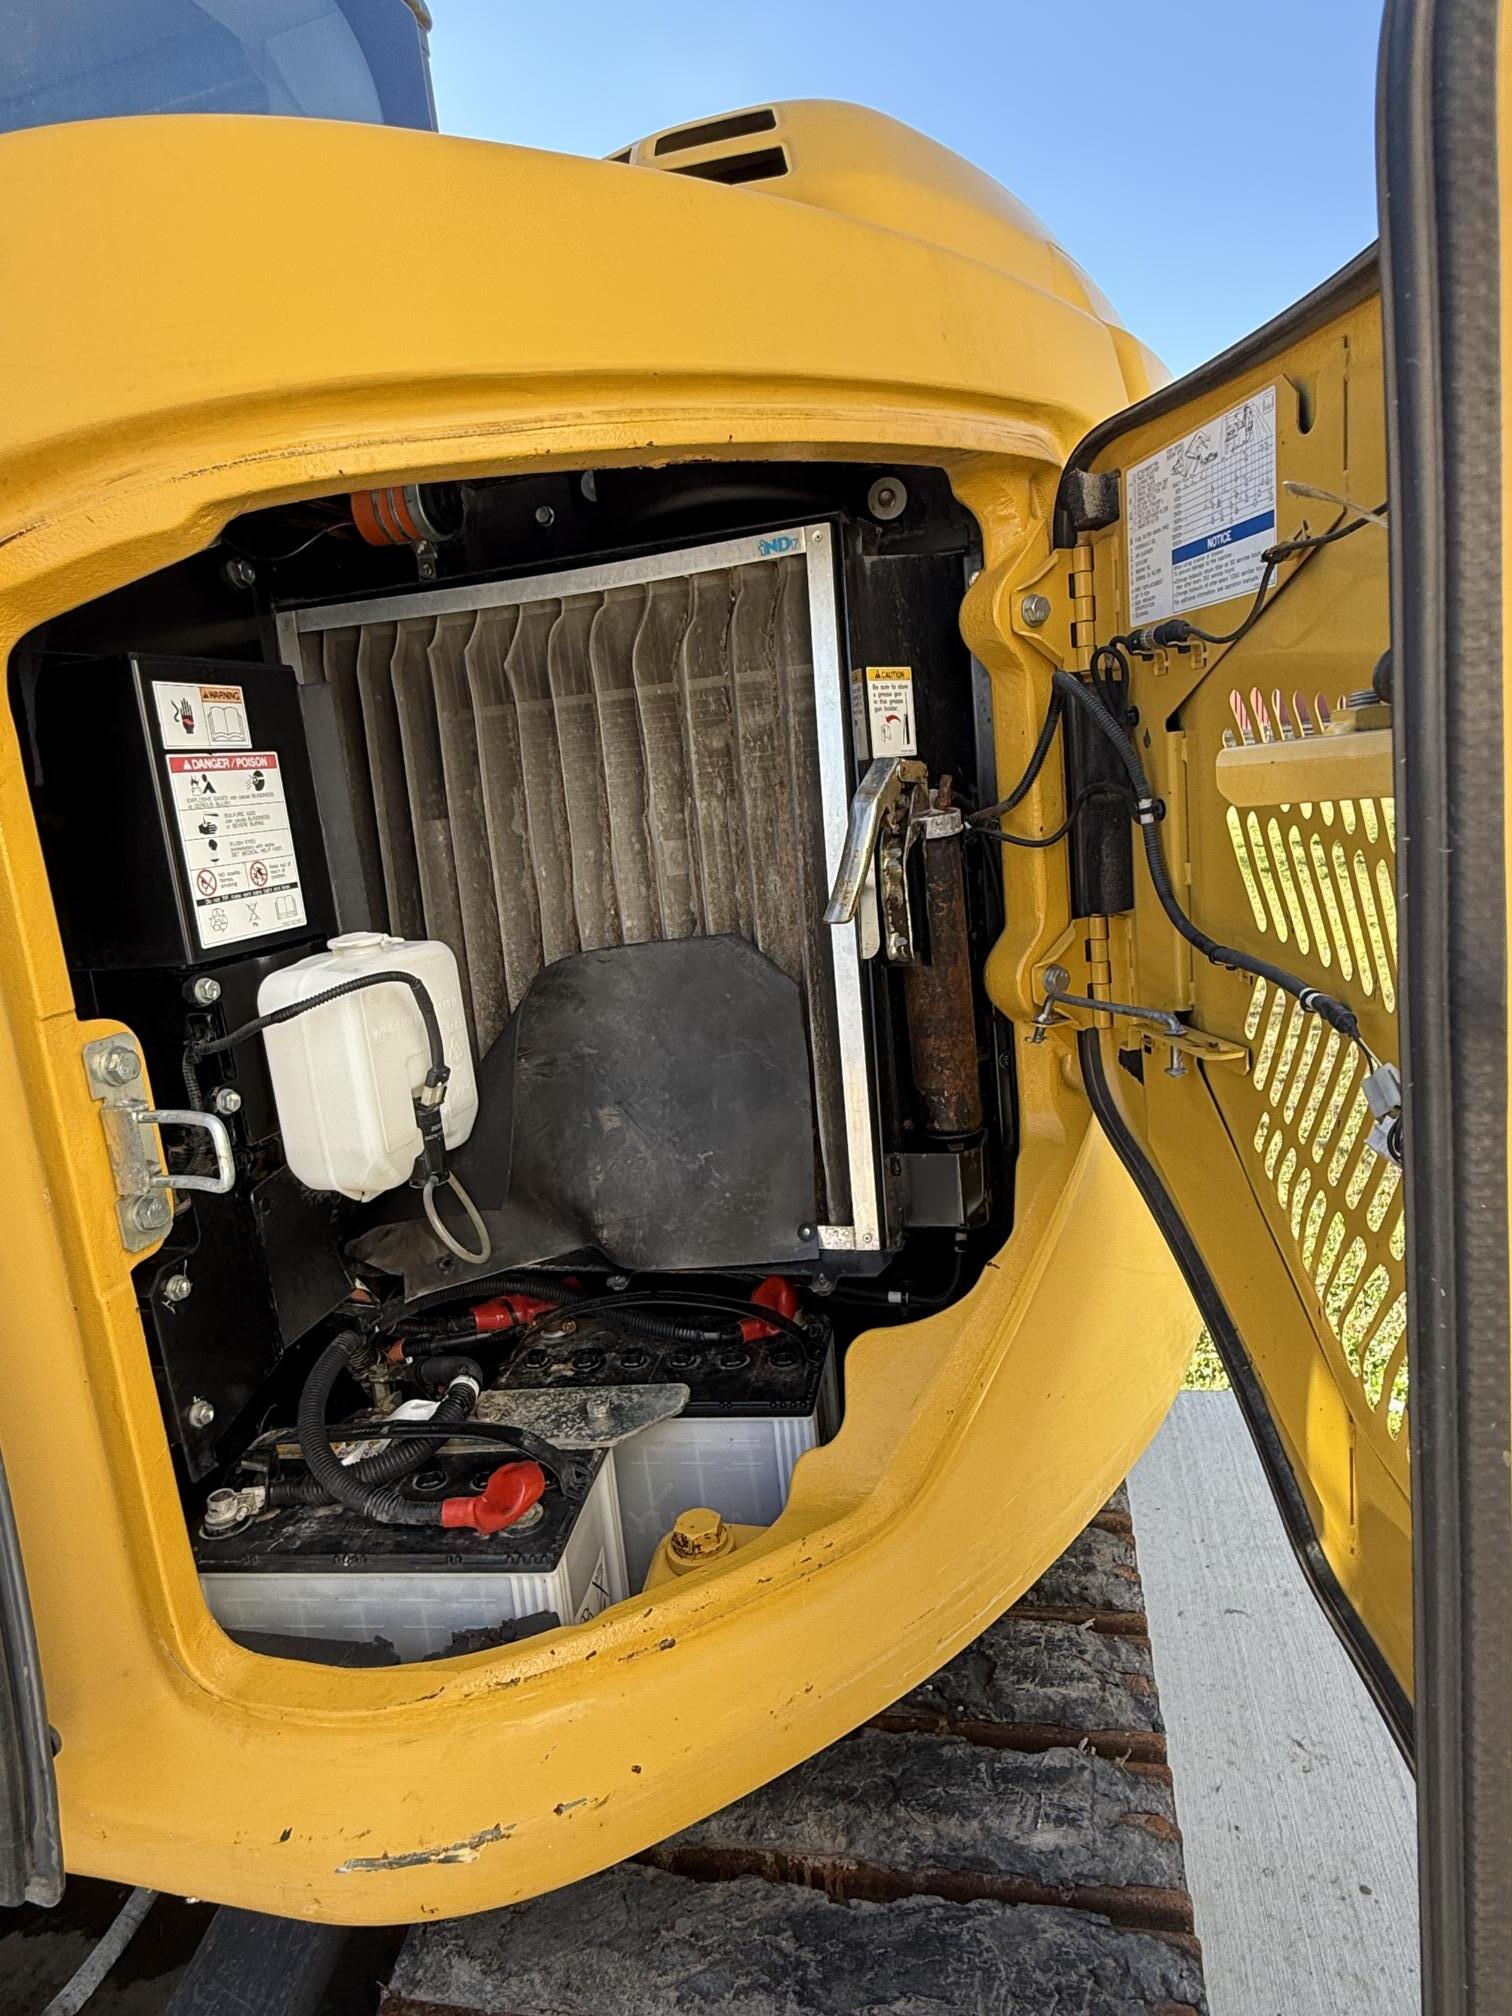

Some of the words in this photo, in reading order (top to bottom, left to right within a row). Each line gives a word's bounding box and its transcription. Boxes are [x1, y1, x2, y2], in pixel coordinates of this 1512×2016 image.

[1207, 530, 1232, 549] NOTICE
[882, 670, 905, 679] CAUTION
[208, 690, 240, 700] WARNING
[191, 758, 230, 770] DANGER
[236, 756, 268, 768] POISON
